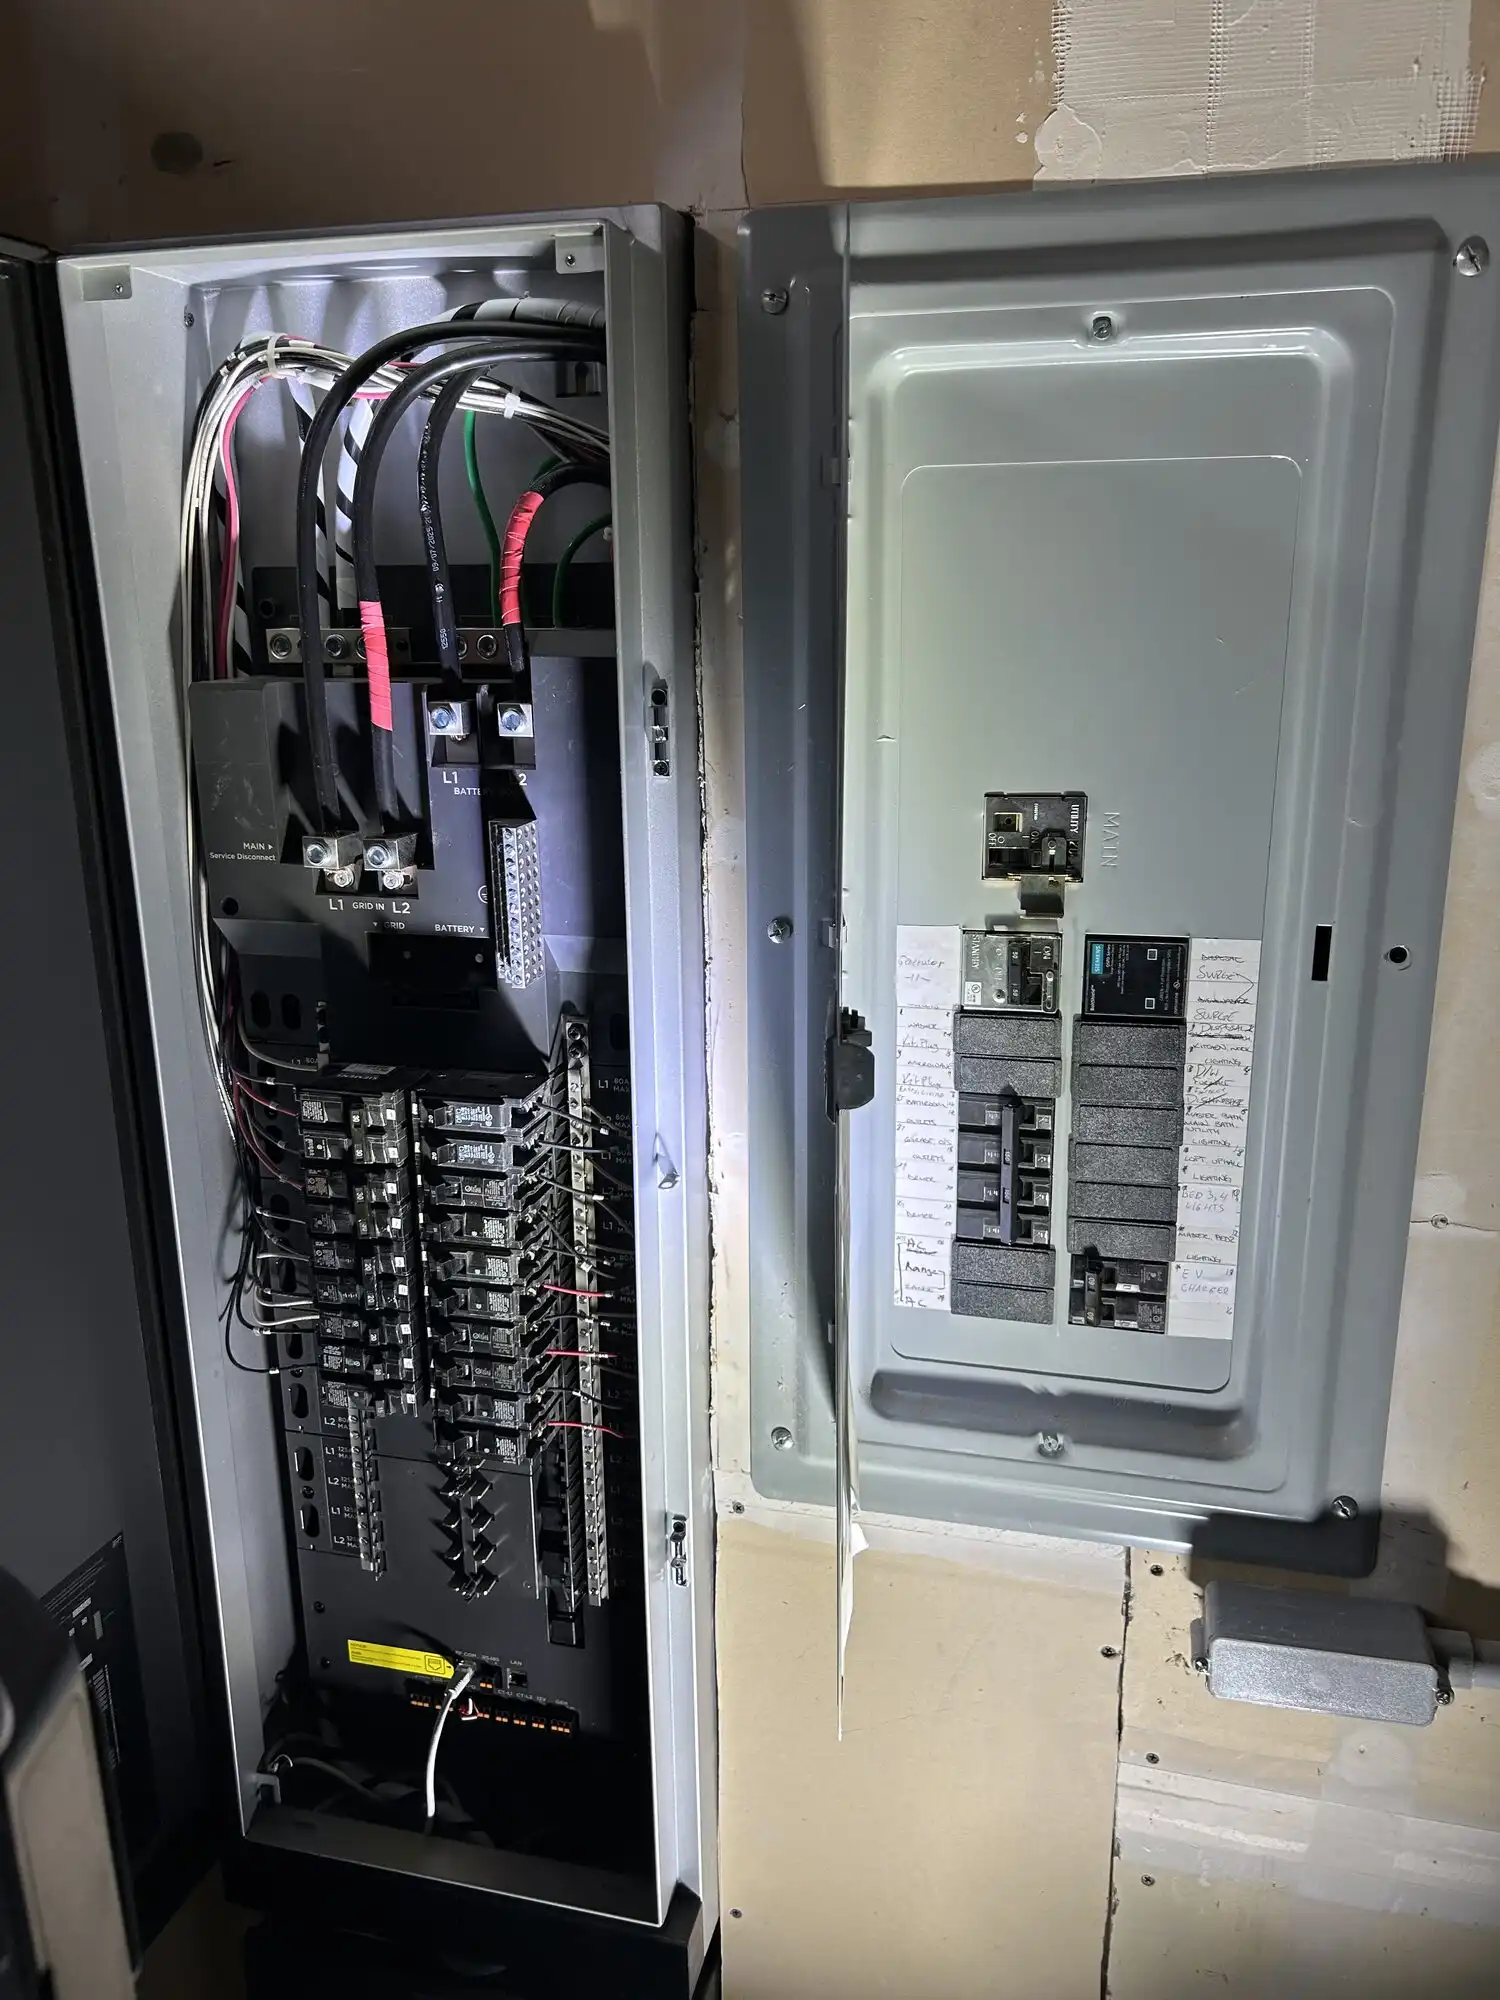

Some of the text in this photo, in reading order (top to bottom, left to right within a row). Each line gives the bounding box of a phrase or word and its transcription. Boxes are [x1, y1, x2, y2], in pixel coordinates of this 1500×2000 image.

[443, 771, 458, 784] L1
[454, 787, 486, 796] BATTE
[1070, 804, 1080, 834] UTILITY
[988, 832, 997, 846] OFF
[1101, 812, 1121, 867] MAIN
[243, 842, 265, 850] MAIN
[209, 852, 277, 862] Service Disconnect
[329, 899, 345, 911] L1
[352, 902, 385, 911] GRID IN
[392, 901, 411, 914] L2
[384, 921, 405, 930] GRID
[434, 924, 475, 934] BATTERY
[971, 934, 981, 969] STANDBY
[1193, 1008, 1239, 1021] SURGE
[598, 1079, 609, 1089] L1
[602, 1221, 613, 1230] L1
[905, 1261, 938, 1276] Range
[324, 1416, 336, 1426] L2
[325, 1446, 335, 1455] L1
[328, 1476, 340, 1486] L2
[331, 1506, 341, 1515] L1
[333, 1535, 346, 1545] L2
